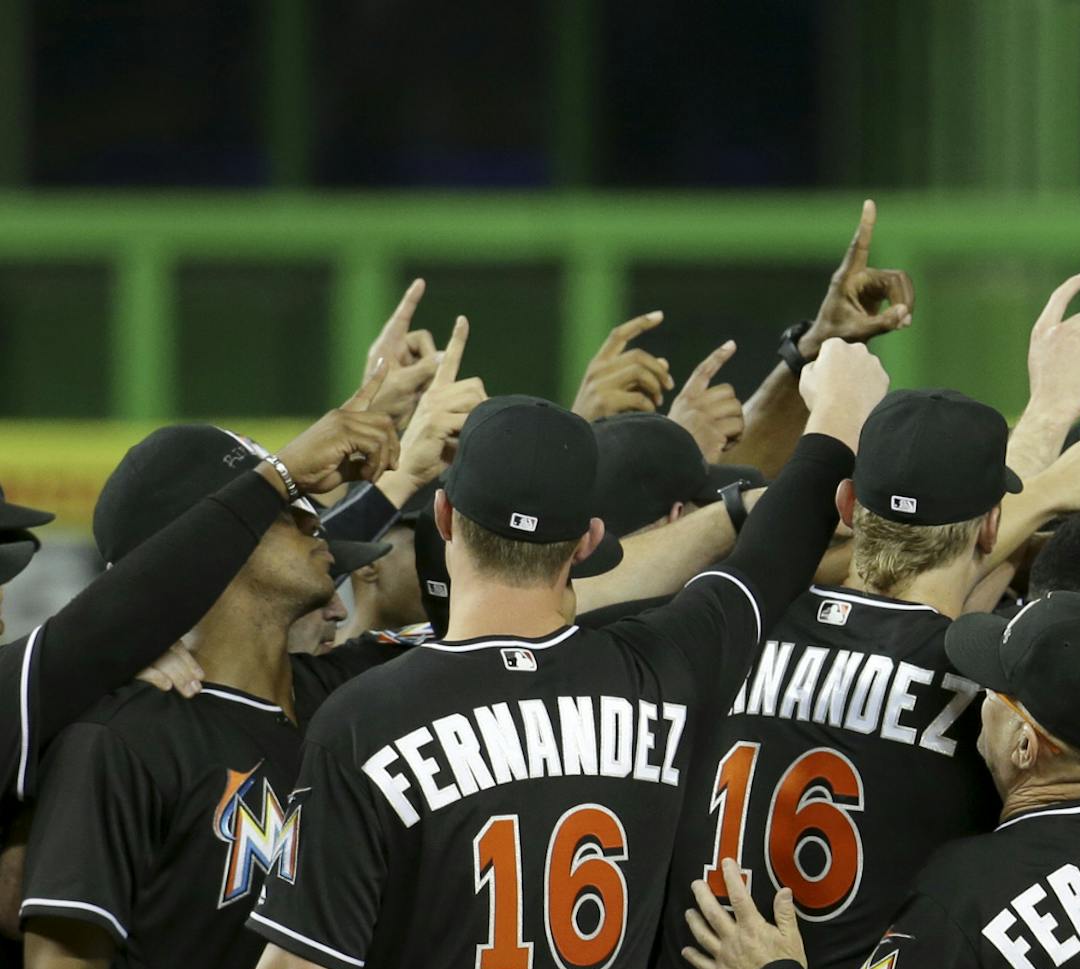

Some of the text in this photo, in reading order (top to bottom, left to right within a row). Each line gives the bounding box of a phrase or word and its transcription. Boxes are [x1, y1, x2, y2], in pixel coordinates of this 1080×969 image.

[362, 696, 687, 829] FERNANDEZ
[728, 640, 980, 757] NANDEZ
[703, 740, 865, 923] 16
